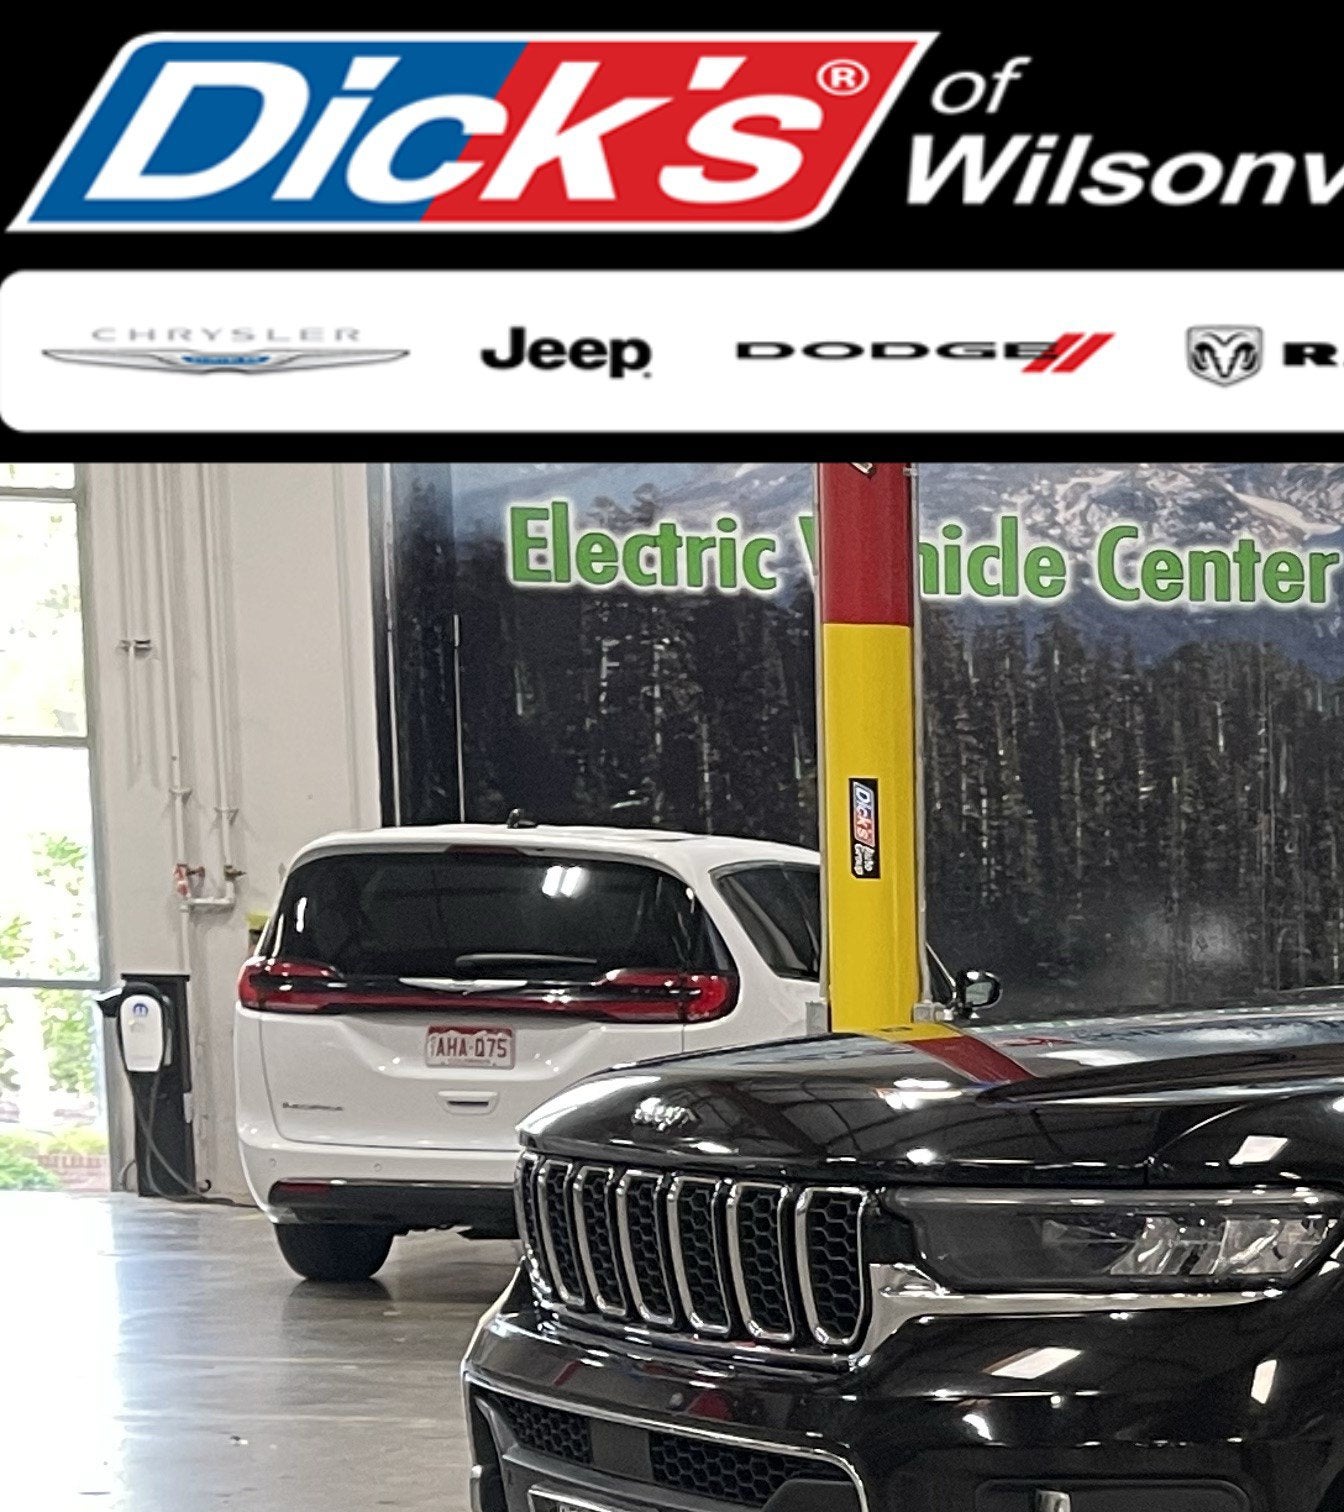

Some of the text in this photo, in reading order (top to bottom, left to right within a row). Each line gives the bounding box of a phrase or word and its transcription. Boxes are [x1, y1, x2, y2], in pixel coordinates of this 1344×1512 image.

[510, 501, 1341, 604] Electric icle Center
